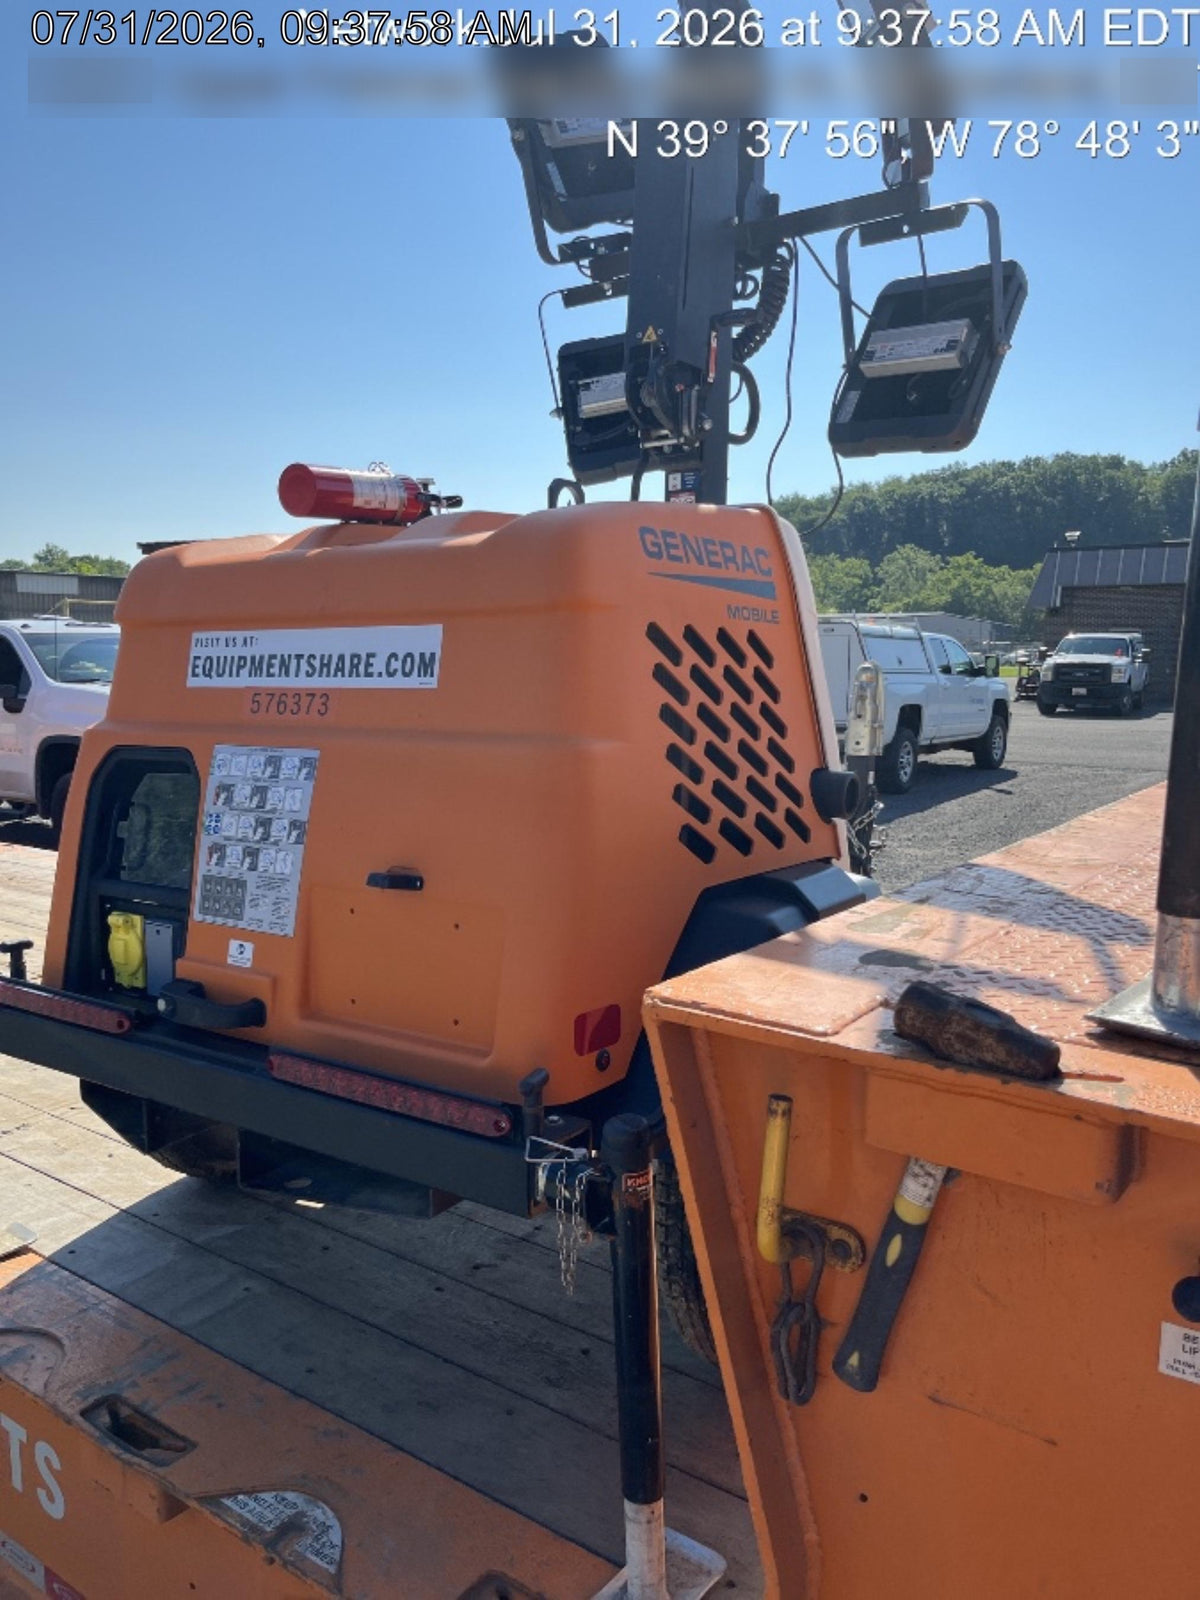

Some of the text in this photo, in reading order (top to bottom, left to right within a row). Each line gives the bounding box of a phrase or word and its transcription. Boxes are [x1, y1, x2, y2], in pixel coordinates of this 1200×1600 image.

[638, 526, 773, 577] GENERAC
[727, 604, 780, 625] MOBILE
[194, 635, 259, 648] VISIT US AT:
[191, 651, 437, 680] EQUIPMENTSHARE.COM
[250, 692, 330, 717] 576373
[1181, 1344, 1200, 1356] LIF
[0, 1411, 65, 1520] TS
